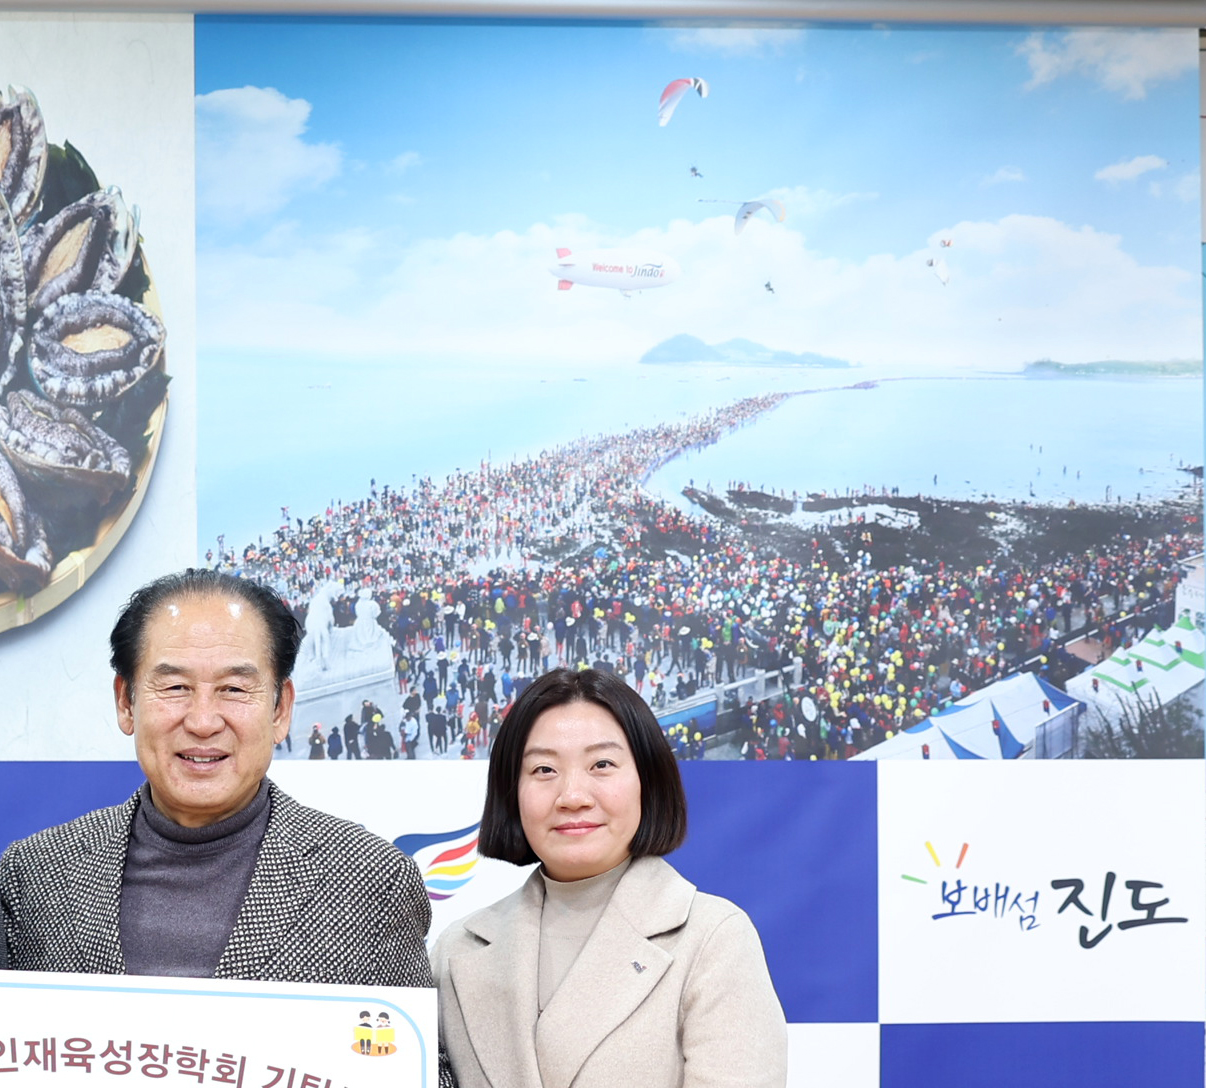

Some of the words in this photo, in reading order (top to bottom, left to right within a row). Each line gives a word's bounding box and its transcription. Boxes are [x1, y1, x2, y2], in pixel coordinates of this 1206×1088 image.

[592, 263, 624, 274] Welcome
[626, 265, 633, 274] to
[631, 264, 659, 278] Jindo
[931, 879, 1041, 932] 보배섬
[1050, 871, 1189, 949] 진도
